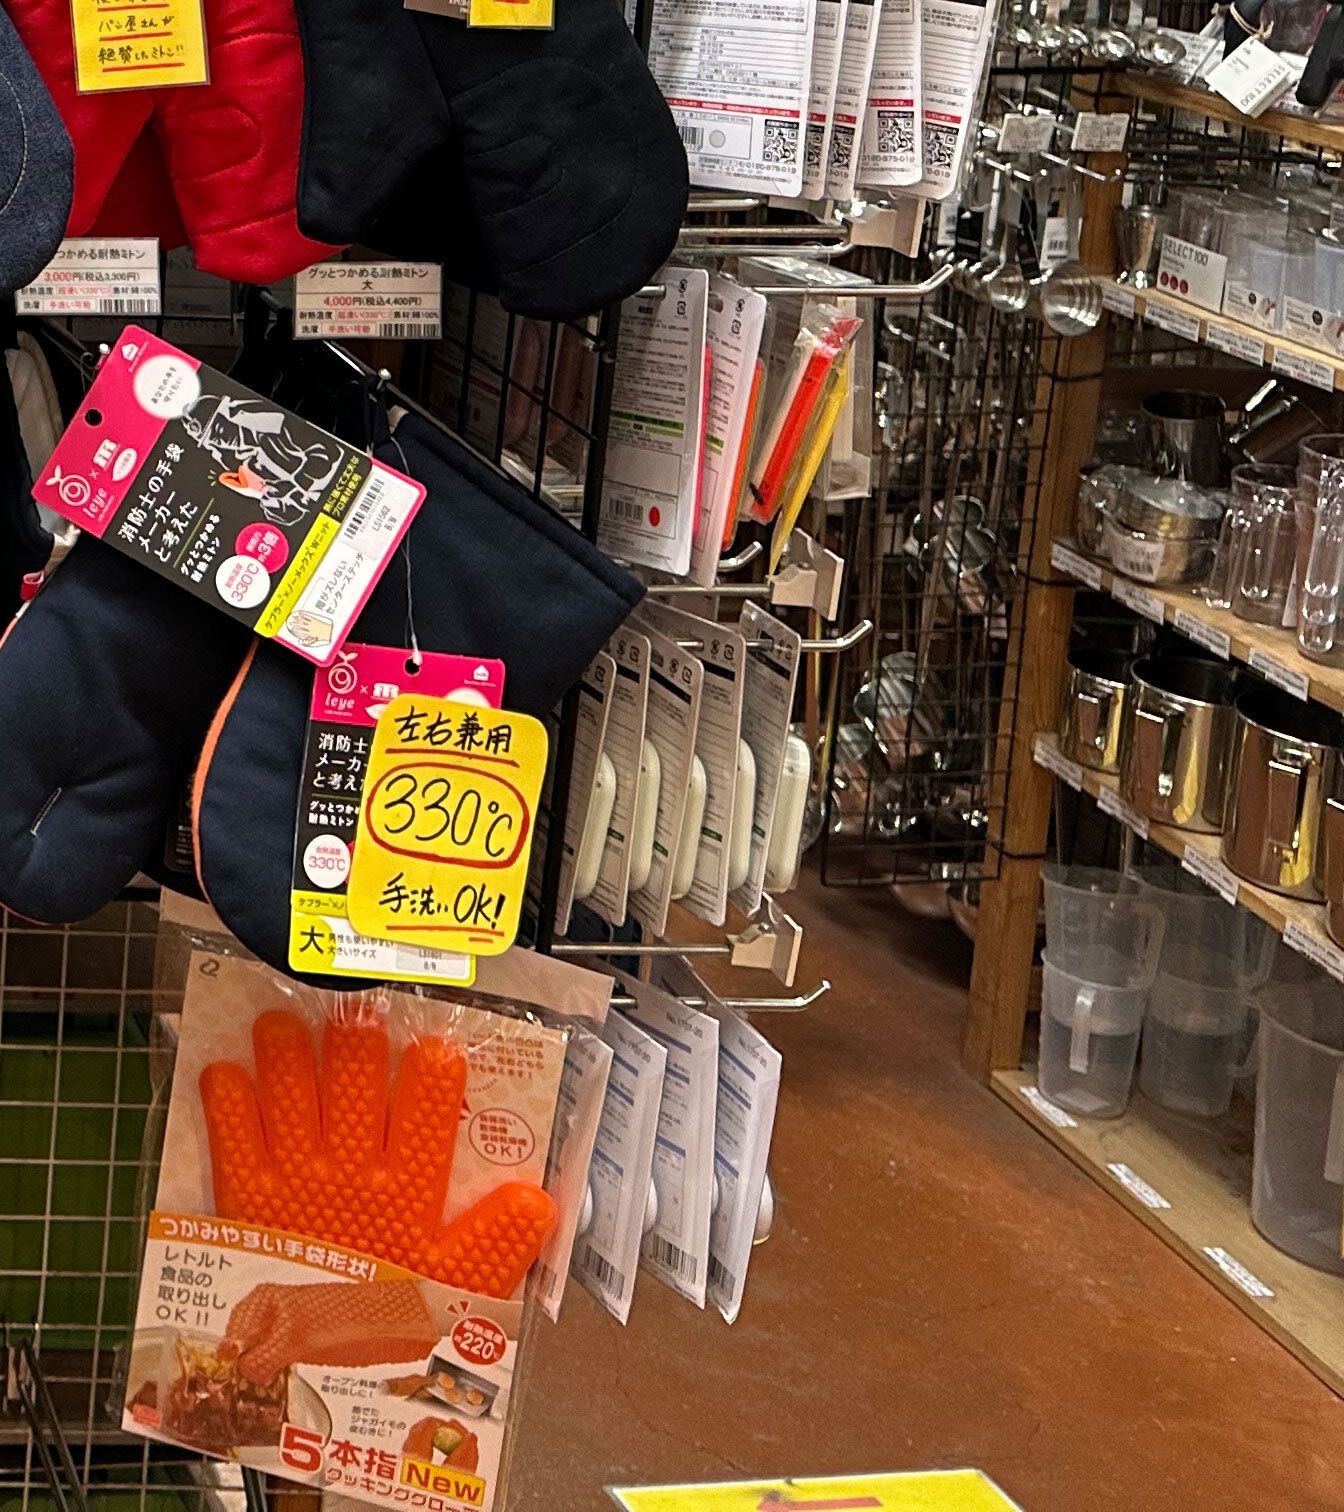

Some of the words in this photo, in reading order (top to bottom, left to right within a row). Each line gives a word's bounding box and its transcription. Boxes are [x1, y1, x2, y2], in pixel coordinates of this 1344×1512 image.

[362, 279, 373, 290] 大
[117, 441, 185, 544] 消防士の手袋
[138, 490, 177, 553] メーカー
[154, 501, 198, 563] と考えた
[394, 704, 513, 755] 左右兼用
[298, 924, 325, 955] 大
[159, 1216, 378, 1283] つかみやすい手袋形状!
[165, 1245, 233, 1271] レトルト
[158, 1284, 227, 1310] 取り出し
[161, 1266, 212, 1288] 食品の
[279, 1422, 397, 1481] 5本指
[406, 1463, 482, 1502] New
